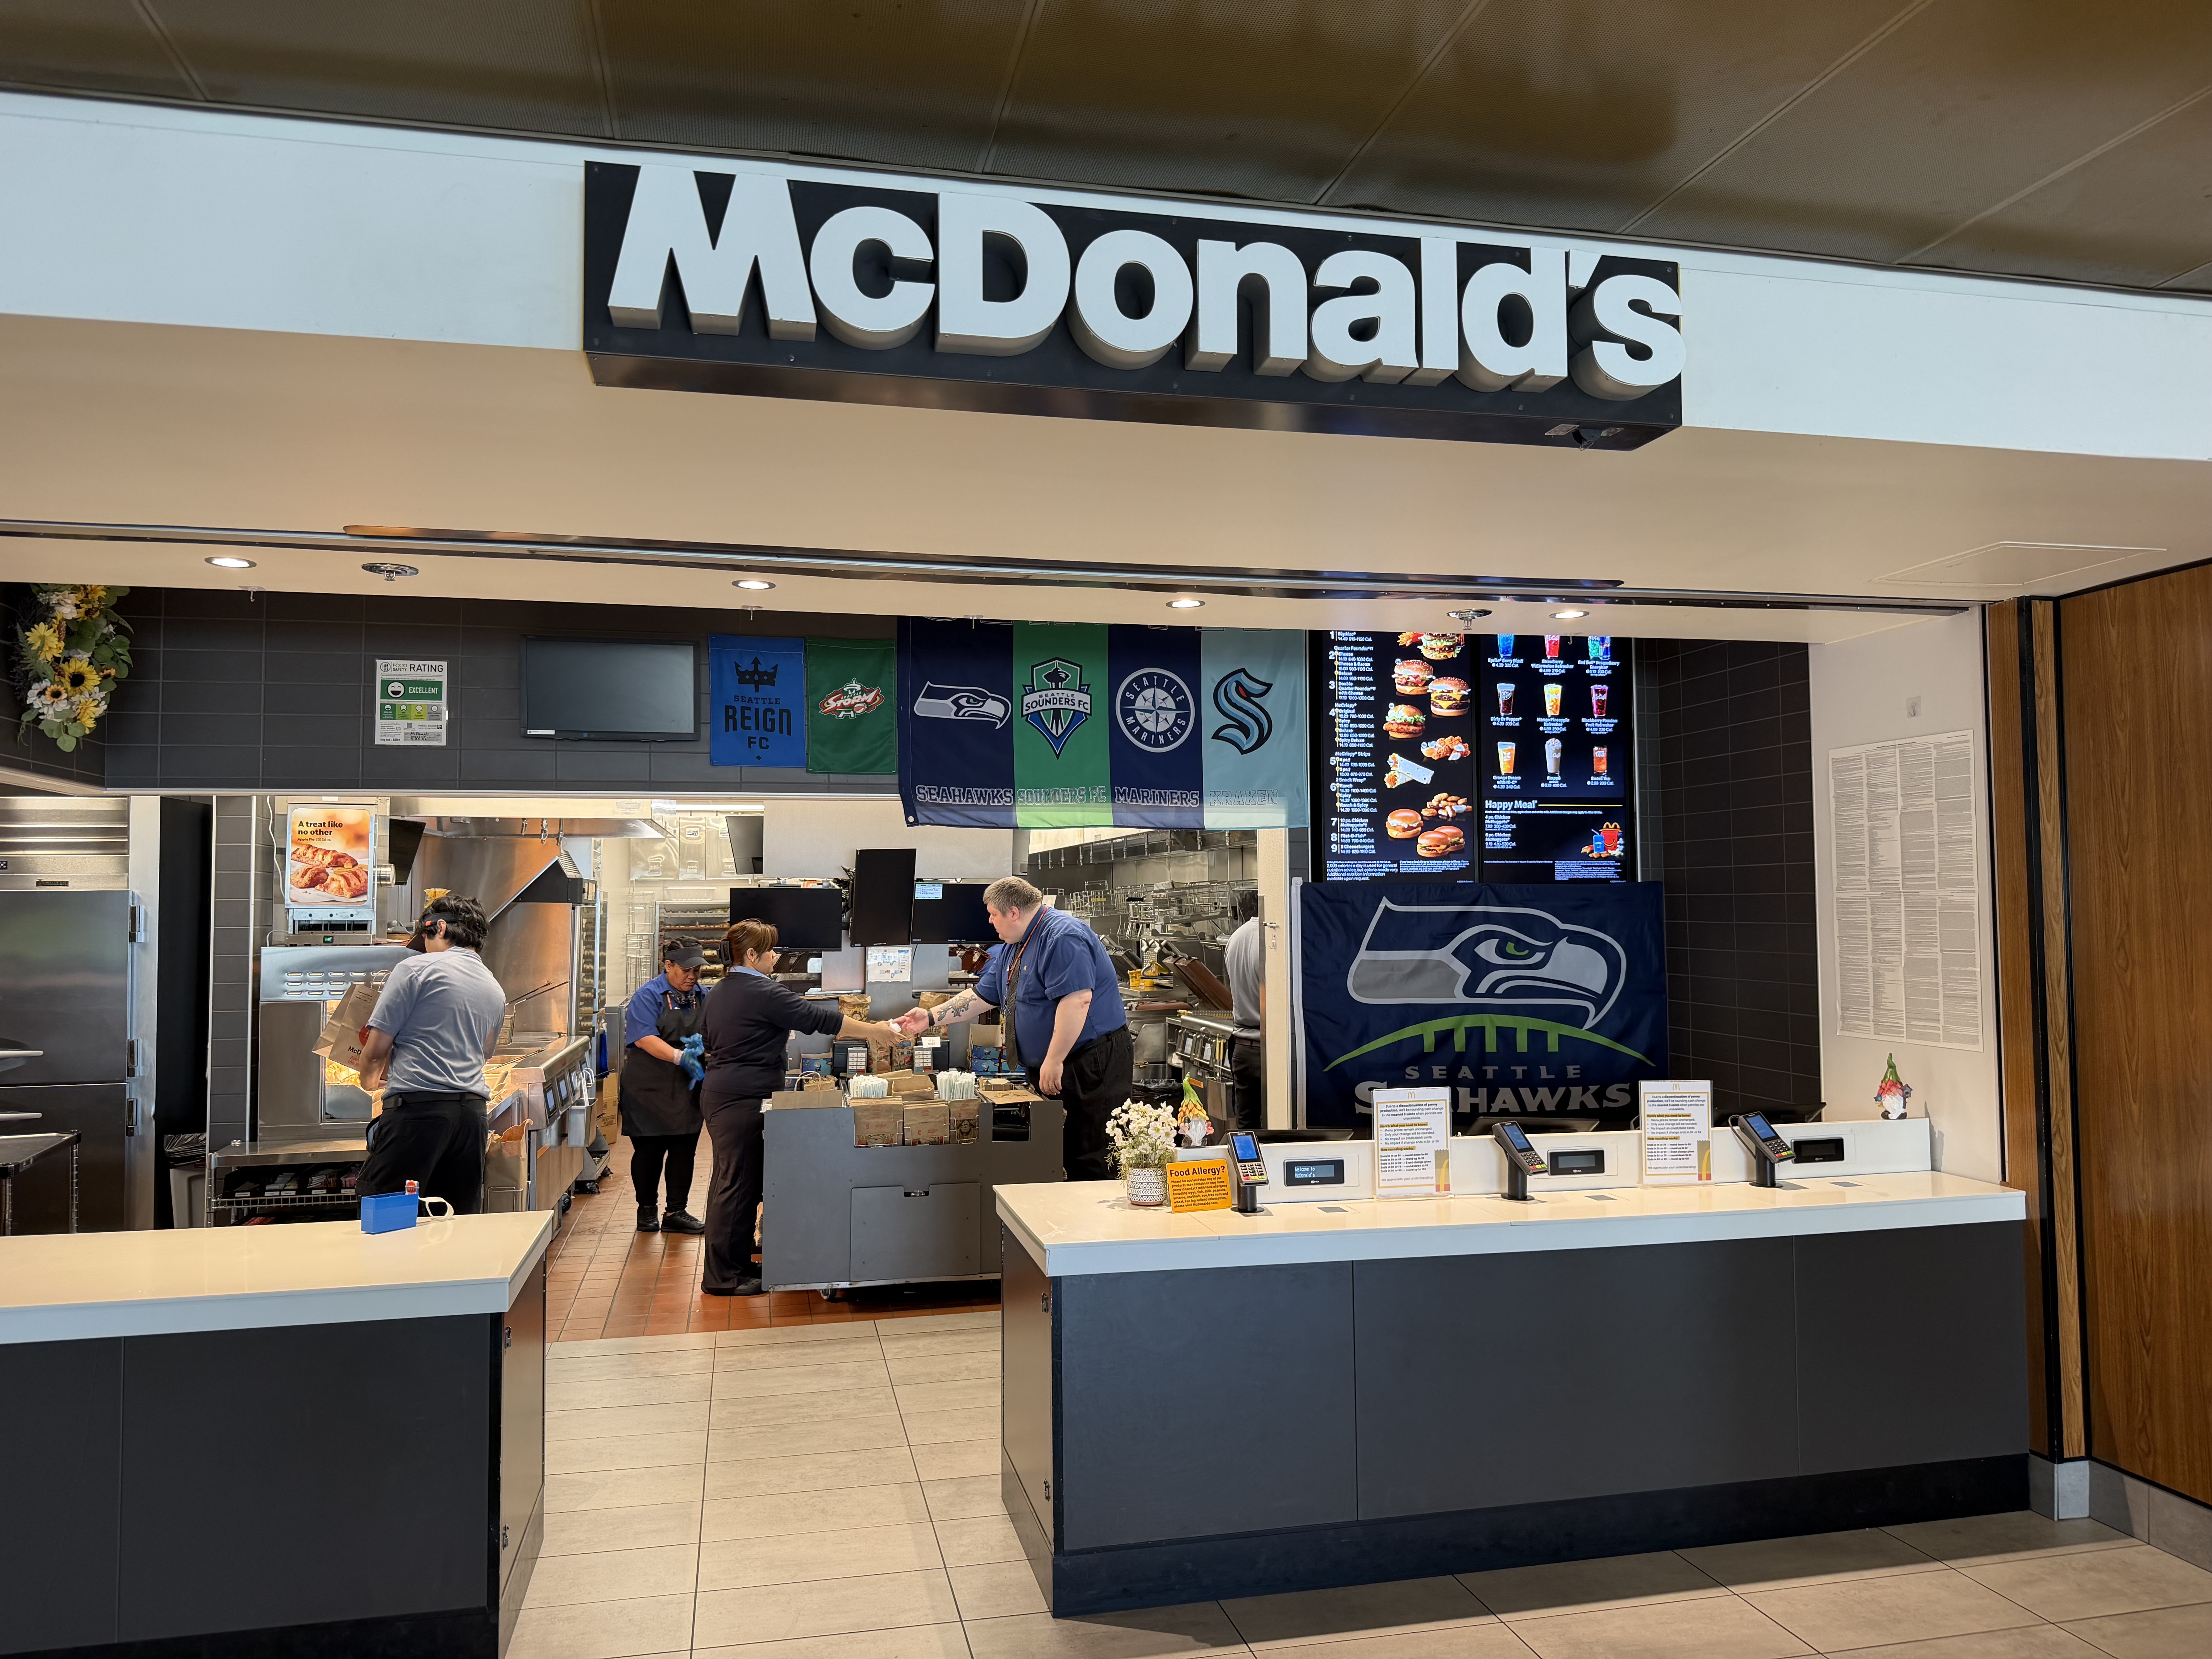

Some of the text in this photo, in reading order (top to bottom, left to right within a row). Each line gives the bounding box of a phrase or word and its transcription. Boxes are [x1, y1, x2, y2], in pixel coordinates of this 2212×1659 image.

[607, 167, 1685, 397] McDonald's
[1329, 651, 1335, 659] 2
[410, 664, 443, 672] RATING
[1126, 676, 1185, 702] SEATTLE
[1329, 681, 1335, 689] 3
[734, 696, 780, 704] SEATTLE
[822, 688, 880, 713] STORM
[841, 691, 862, 699] SEATTLE
[1025, 697, 1089, 711] SOUNDERS FC
[1329, 708, 1335, 716] 4
[725, 705, 792, 736] REIGN
[1126, 716, 1186, 744] MARINERS
[748, 736, 769, 749] FC
[1330, 757, 1336, 765] 5
[916, 785, 1013, 805] SEAHAWKS
[1017, 786, 1106, 805] SOUNDERS FC
[1115, 787, 1199, 807] MARINERS
[1209, 790, 1278, 806] KRAKEN
[1485, 800, 1513, 810] Happy
[1405, 1065, 1581, 1079] SEATTLE
[1354, 1081, 1631, 1114] SHAWKS
[1170, 1166, 1225, 1177] Food Allergy?
